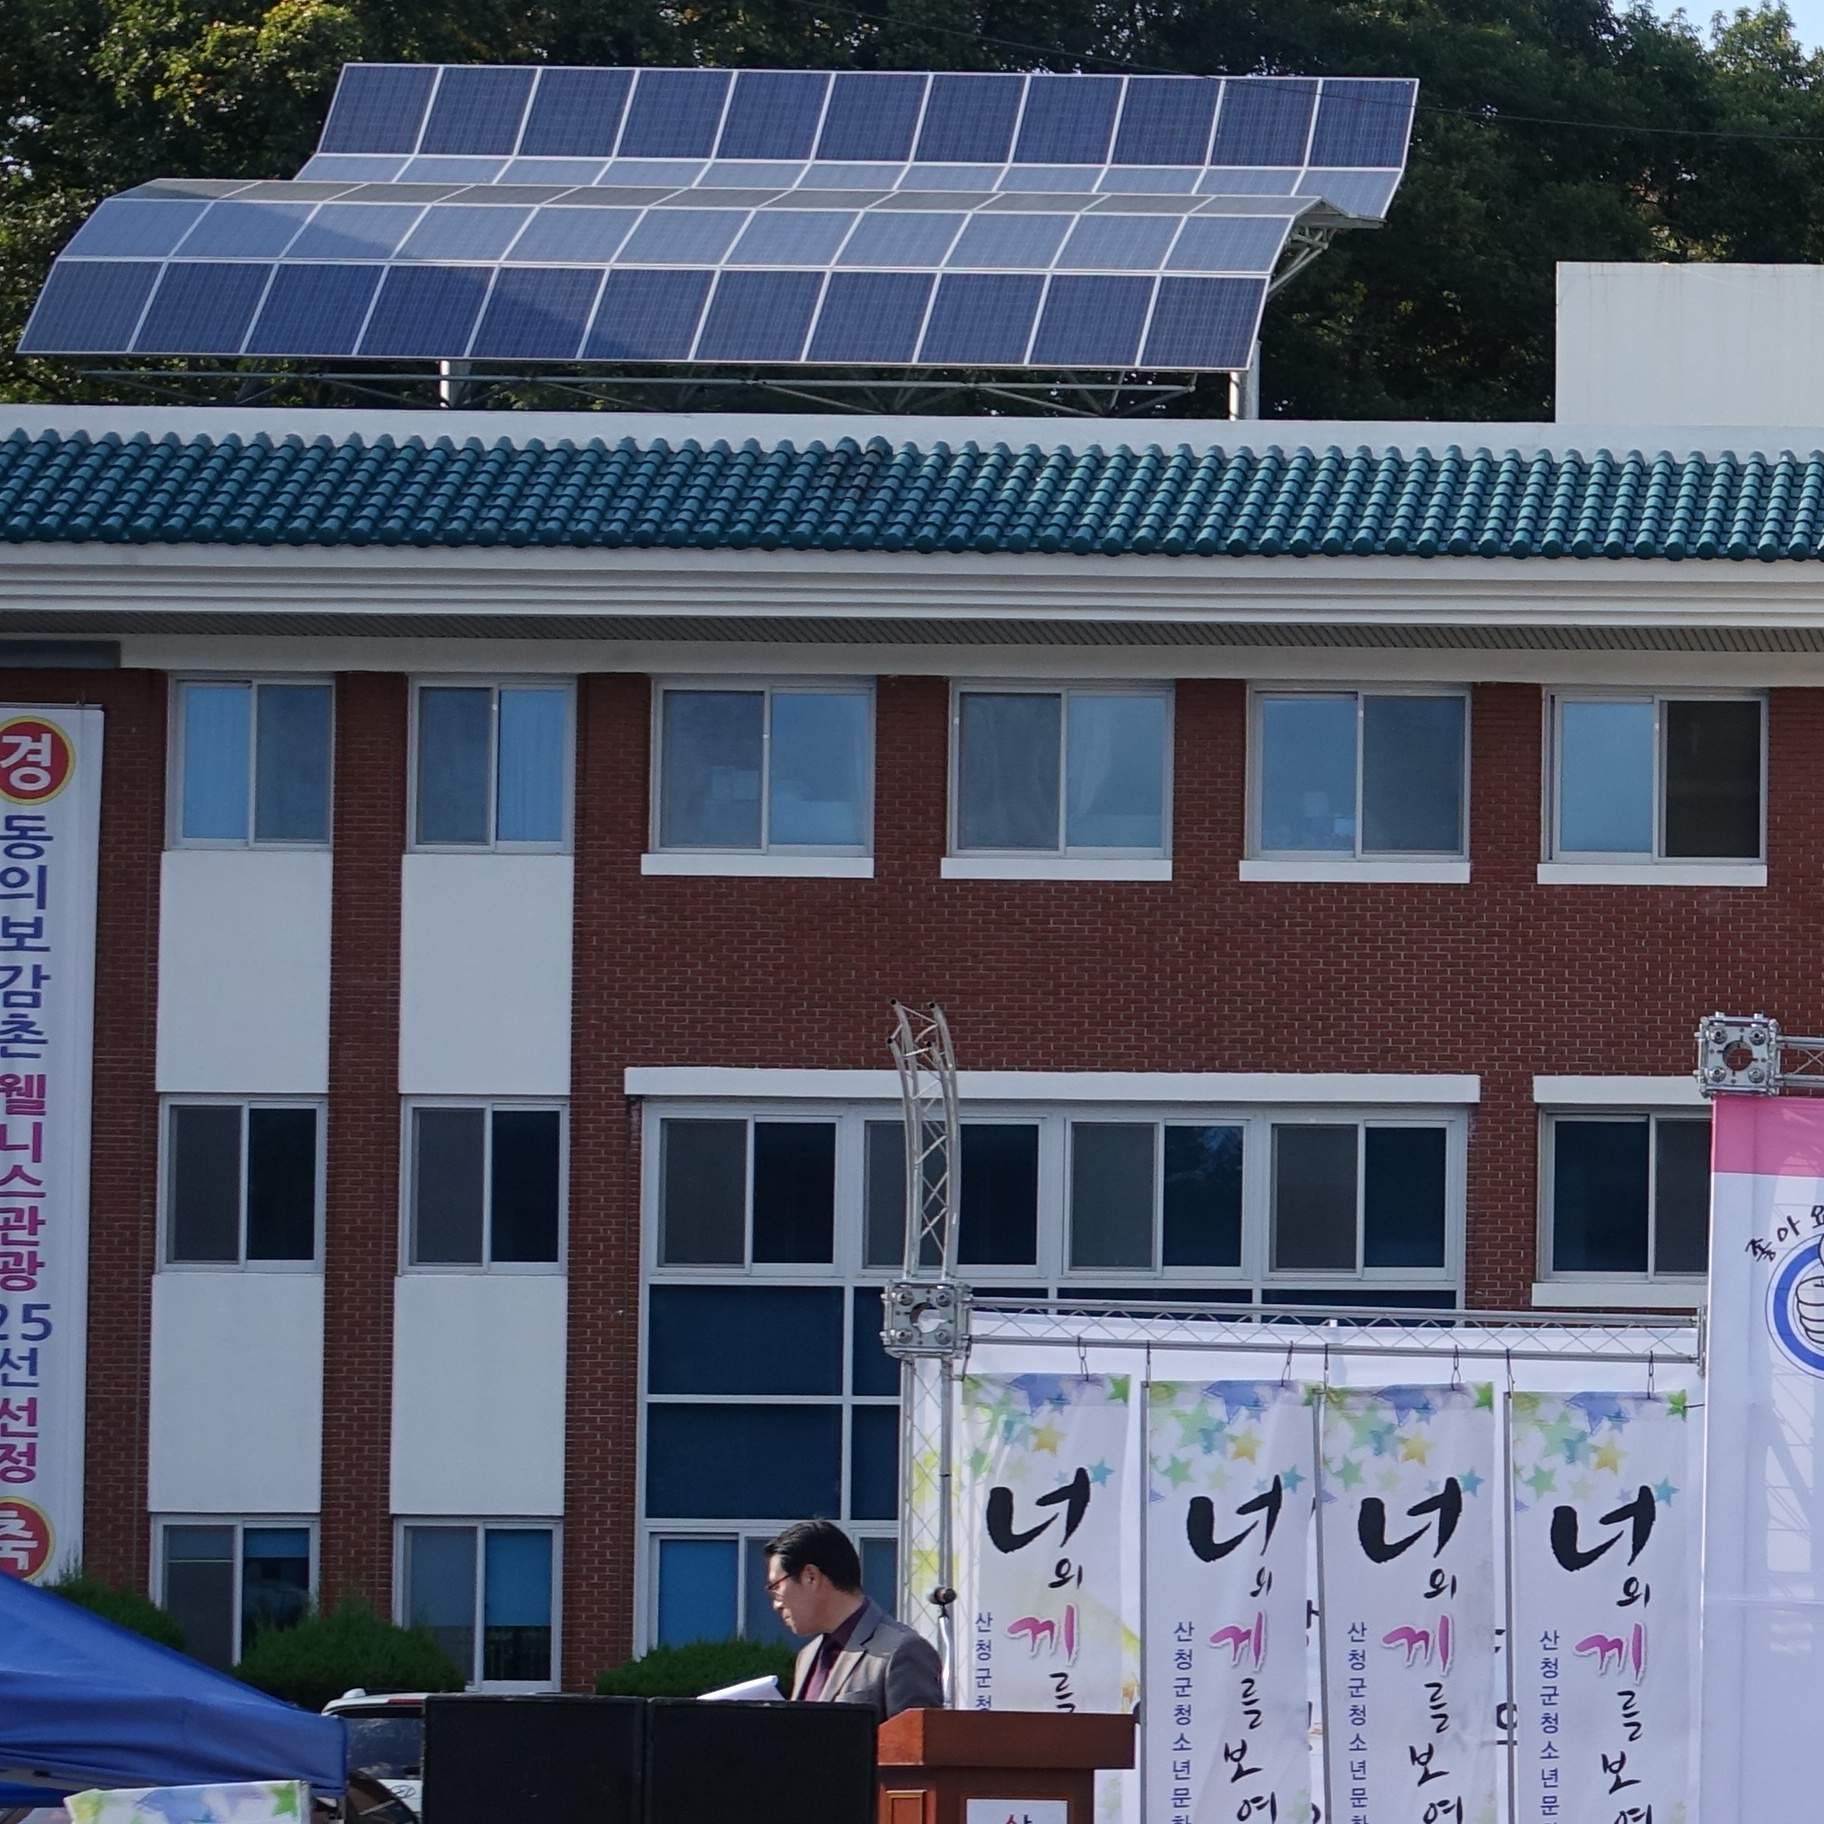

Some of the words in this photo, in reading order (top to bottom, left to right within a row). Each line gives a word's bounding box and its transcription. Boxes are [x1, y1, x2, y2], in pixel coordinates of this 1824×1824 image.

[1, 733, 52, 790] 경
[986, 1468, 1091, 1589] 너의
[1187, 1475, 1282, 1598] 너의
[1358, 1477, 1463, 1599] 너의
[1549, 1485, 1657, 1608] 너의
